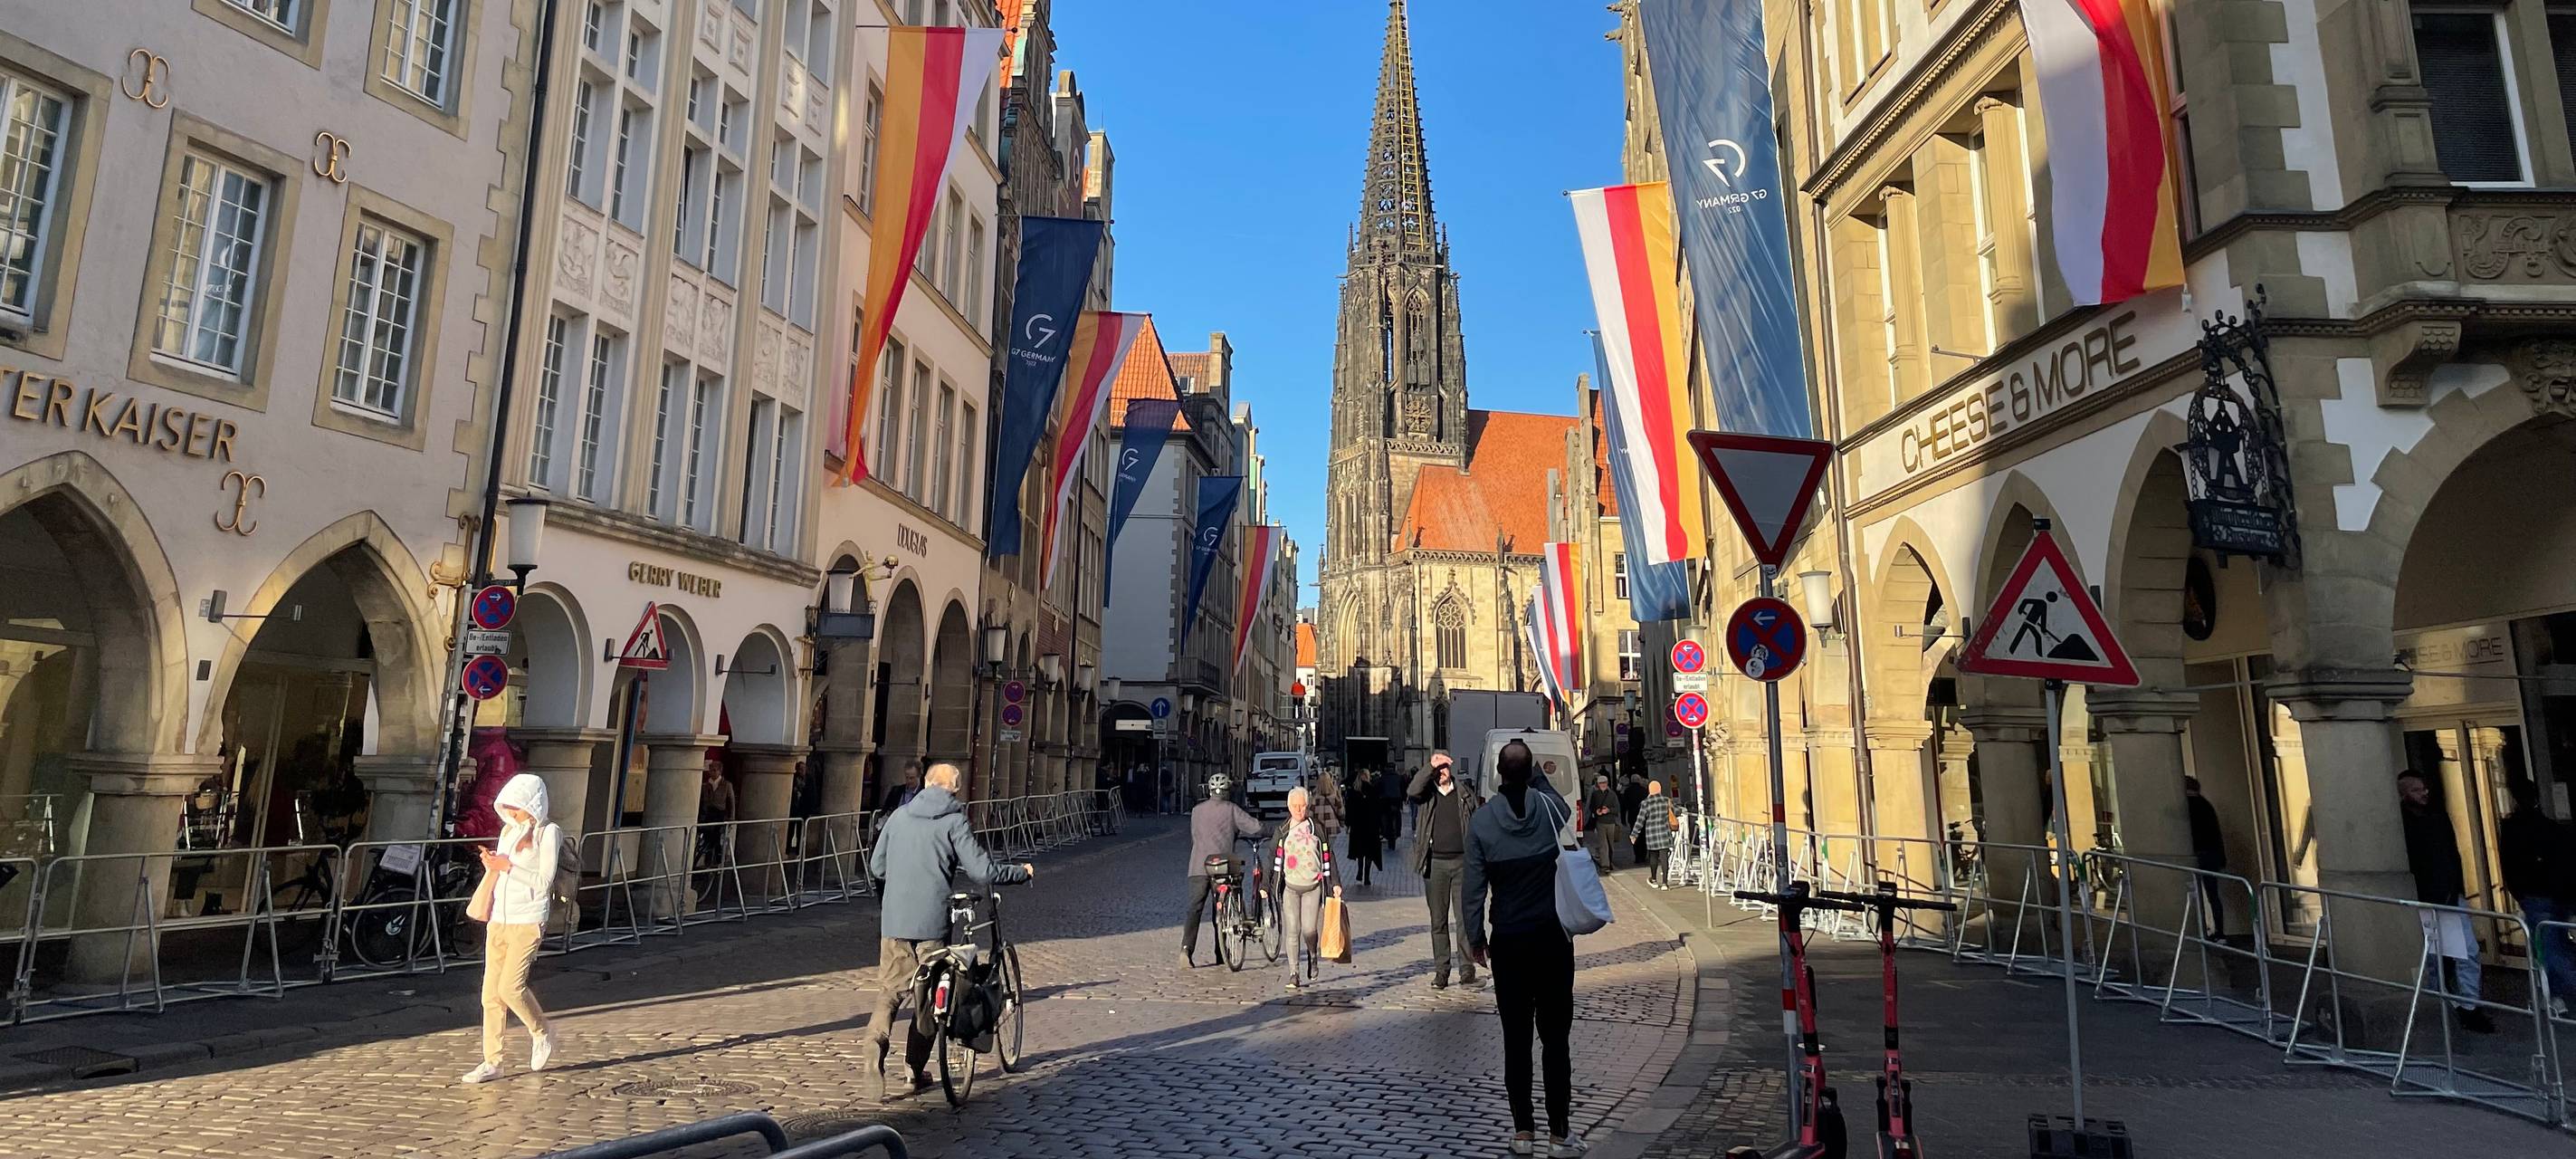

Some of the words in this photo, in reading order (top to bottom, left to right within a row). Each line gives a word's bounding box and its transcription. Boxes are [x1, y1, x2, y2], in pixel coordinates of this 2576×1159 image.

[1021, 350, 1056, 363] GERMANY
[1901, 379, 2008, 474] CHEESE
[2009, 371, 2030, 423] &
[2033, 310, 2141, 411] MORE
[81, 388, 240, 464] KAISER
[897, 522, 928, 558] DOUGLAS
[628, 560, 674, 588] GERRY
[678, 571, 722, 599] WEBER
[2454, 637, 2504, 661] MORE
